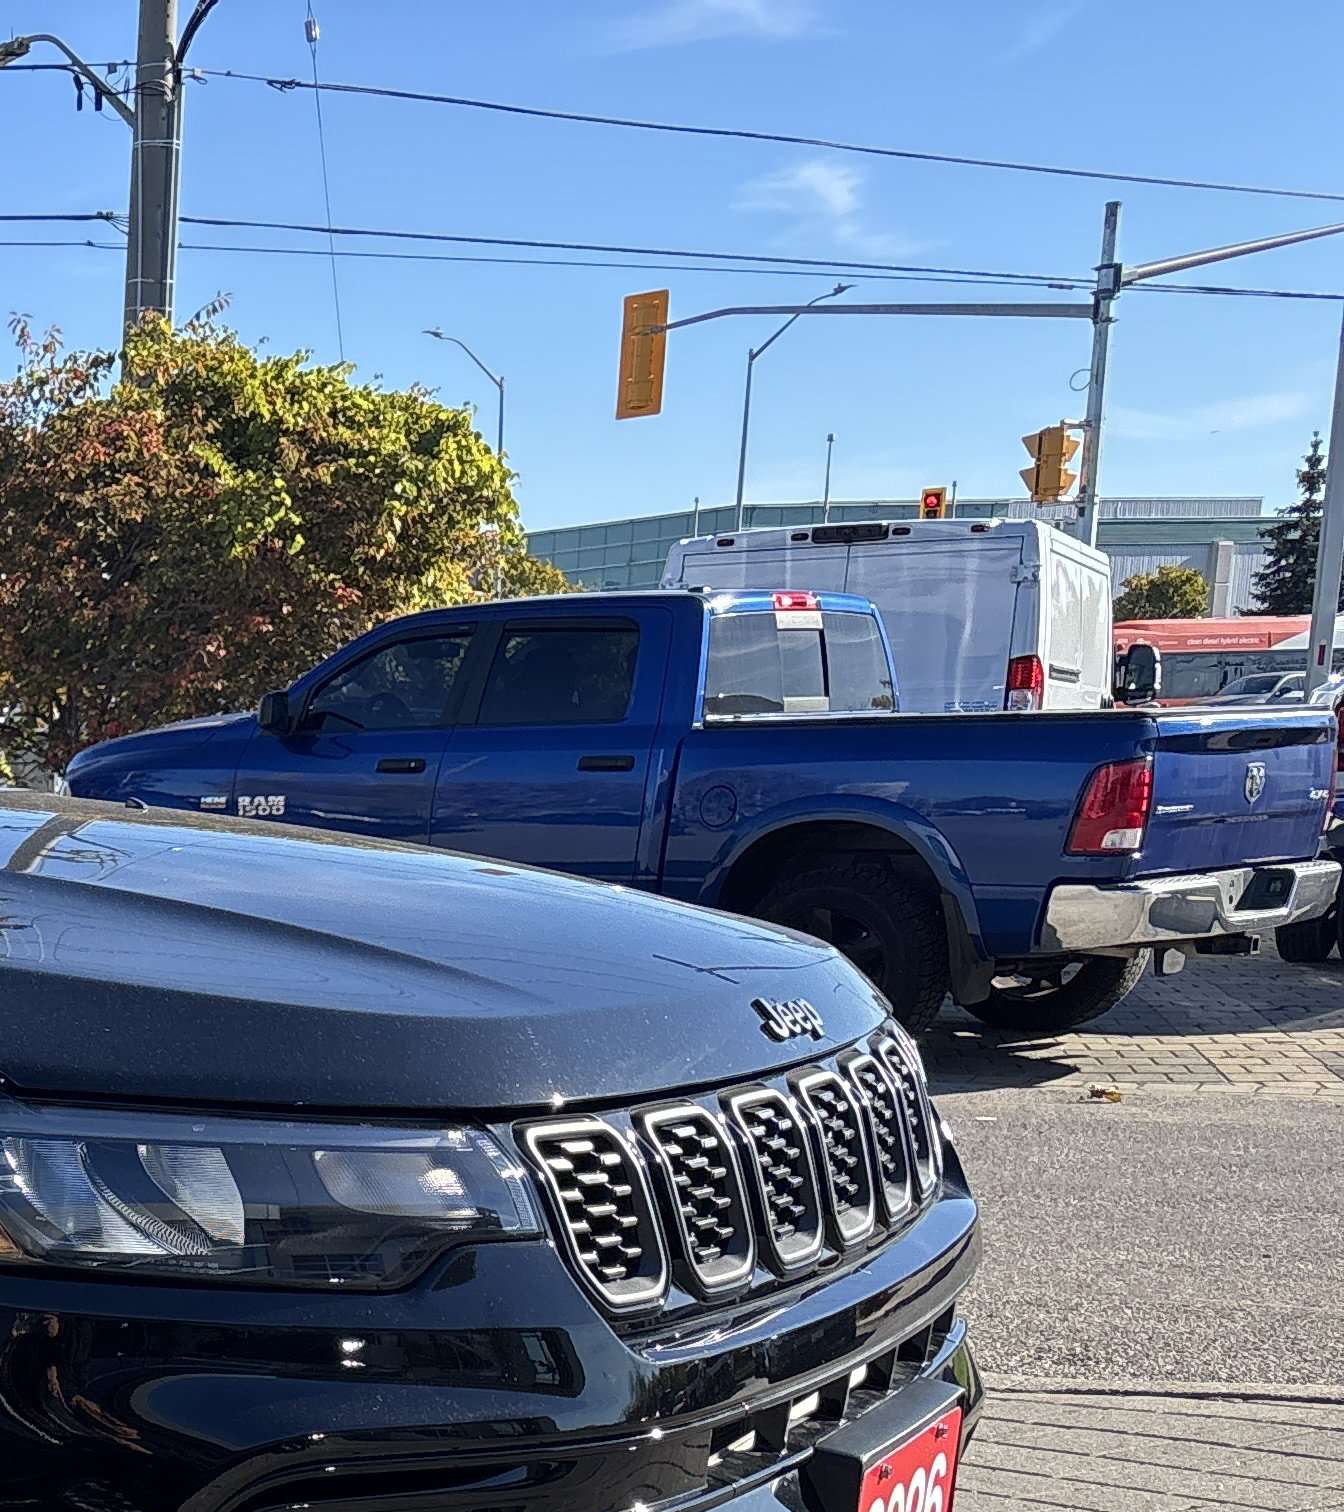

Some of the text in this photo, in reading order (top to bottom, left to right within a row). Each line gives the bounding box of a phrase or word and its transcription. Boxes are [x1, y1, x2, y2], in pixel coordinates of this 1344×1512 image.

[237, 795, 286, 806] RAM
[237, 805, 285, 817] 1500
[750, 997, 826, 1042] Jeep
